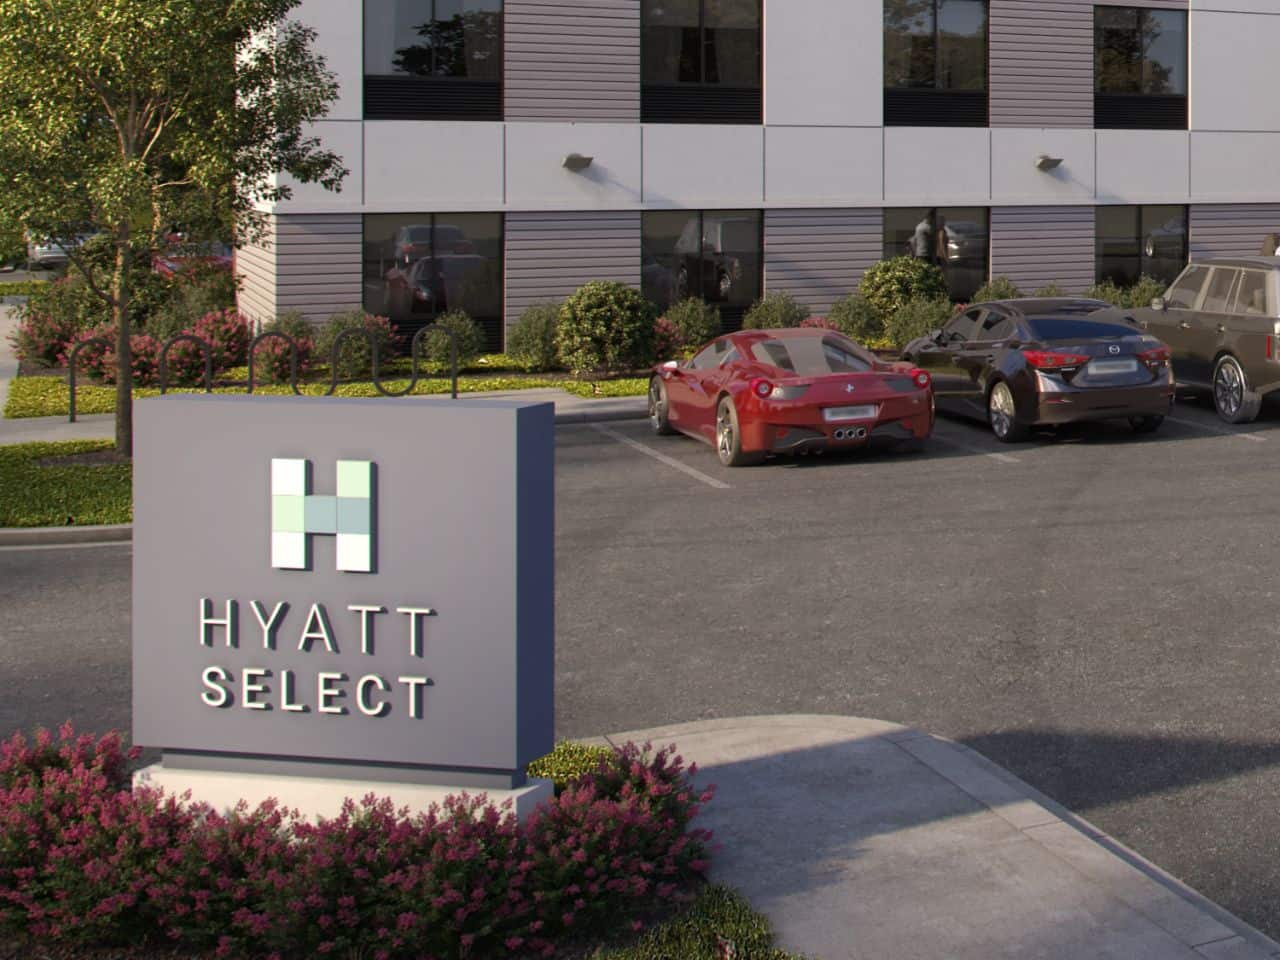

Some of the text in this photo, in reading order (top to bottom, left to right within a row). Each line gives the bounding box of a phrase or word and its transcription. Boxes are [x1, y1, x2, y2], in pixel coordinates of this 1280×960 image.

[271, 458, 374, 573] H
[199, 597, 435, 657] HYATT
[200, 665, 432, 719] SELECT
